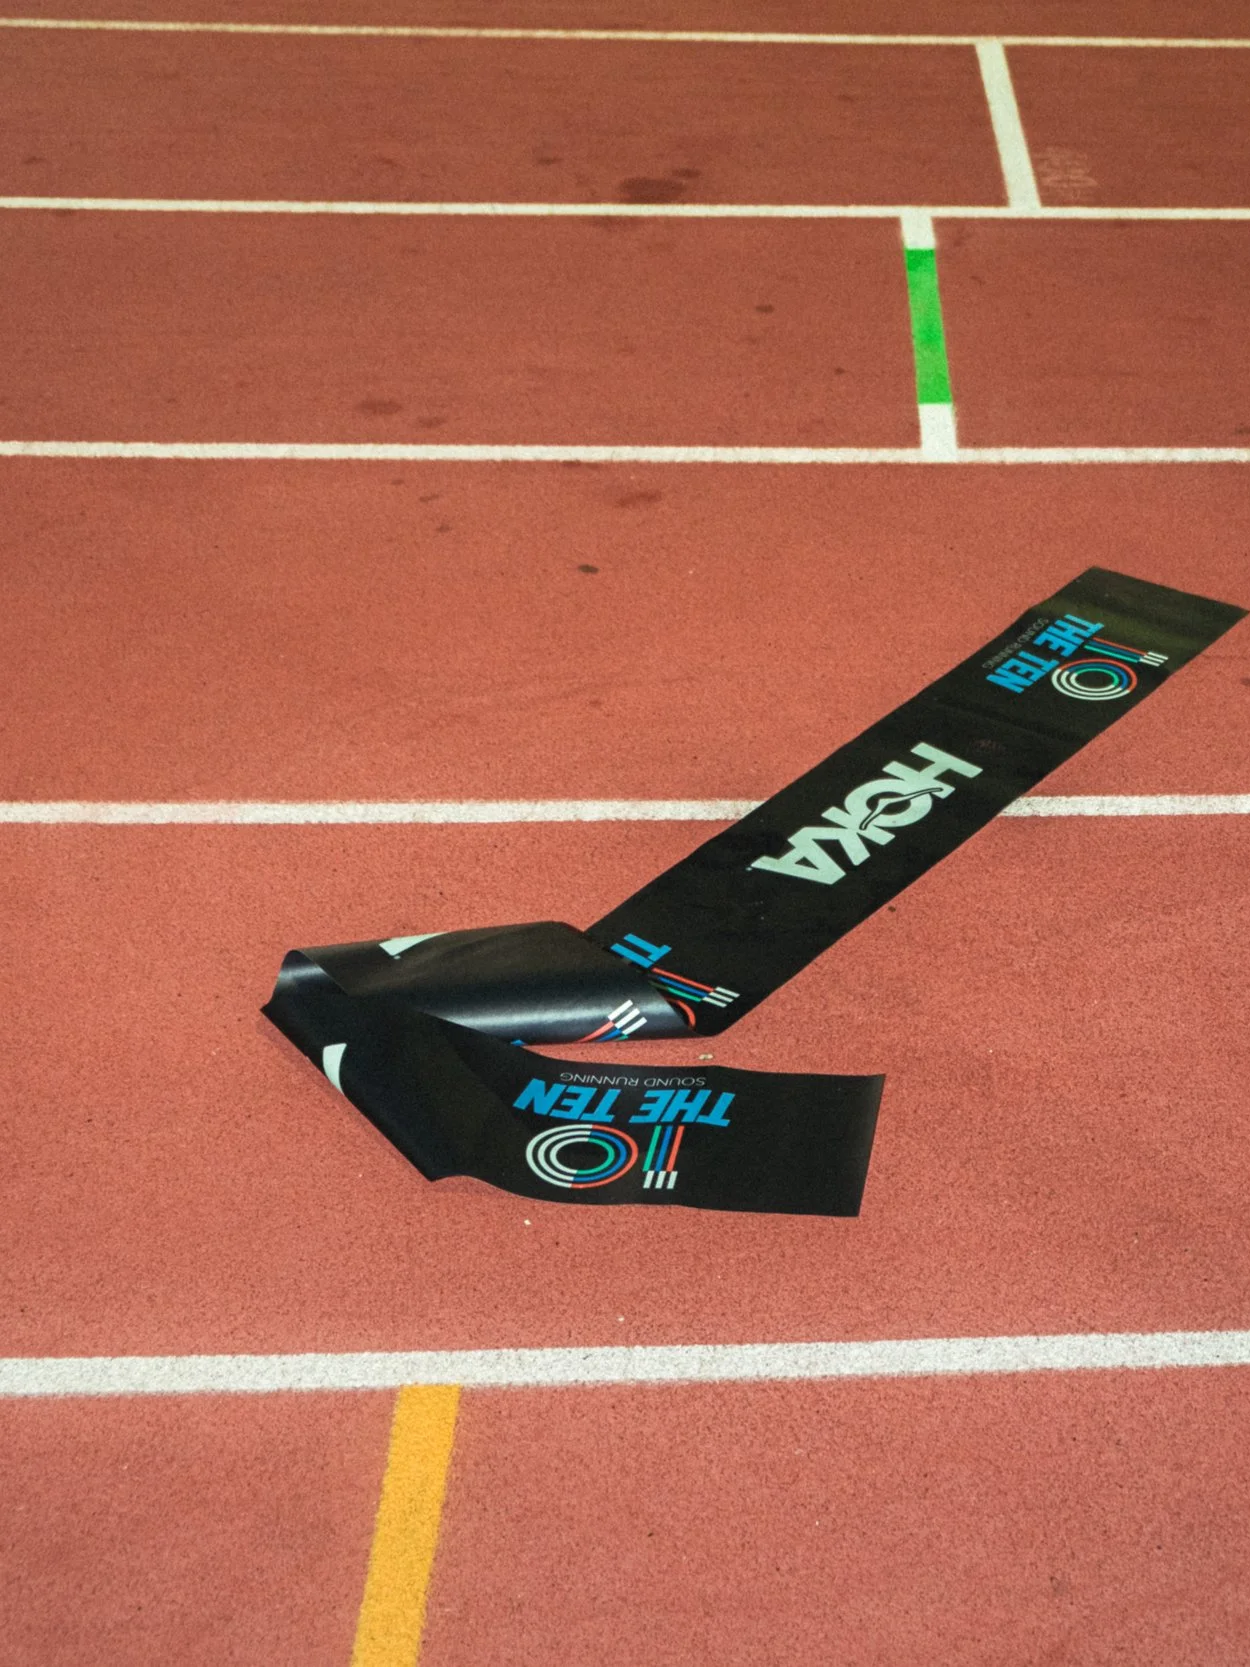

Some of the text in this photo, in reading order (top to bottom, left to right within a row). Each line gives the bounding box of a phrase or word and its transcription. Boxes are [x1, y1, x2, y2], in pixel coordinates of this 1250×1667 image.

[986, 614, 1104, 693] THE TEN
[751, 742, 983, 885] HOKA
[513, 1078, 735, 1127] THE TEN
[560, 1071, 706, 1087] SOUND RUNNING
